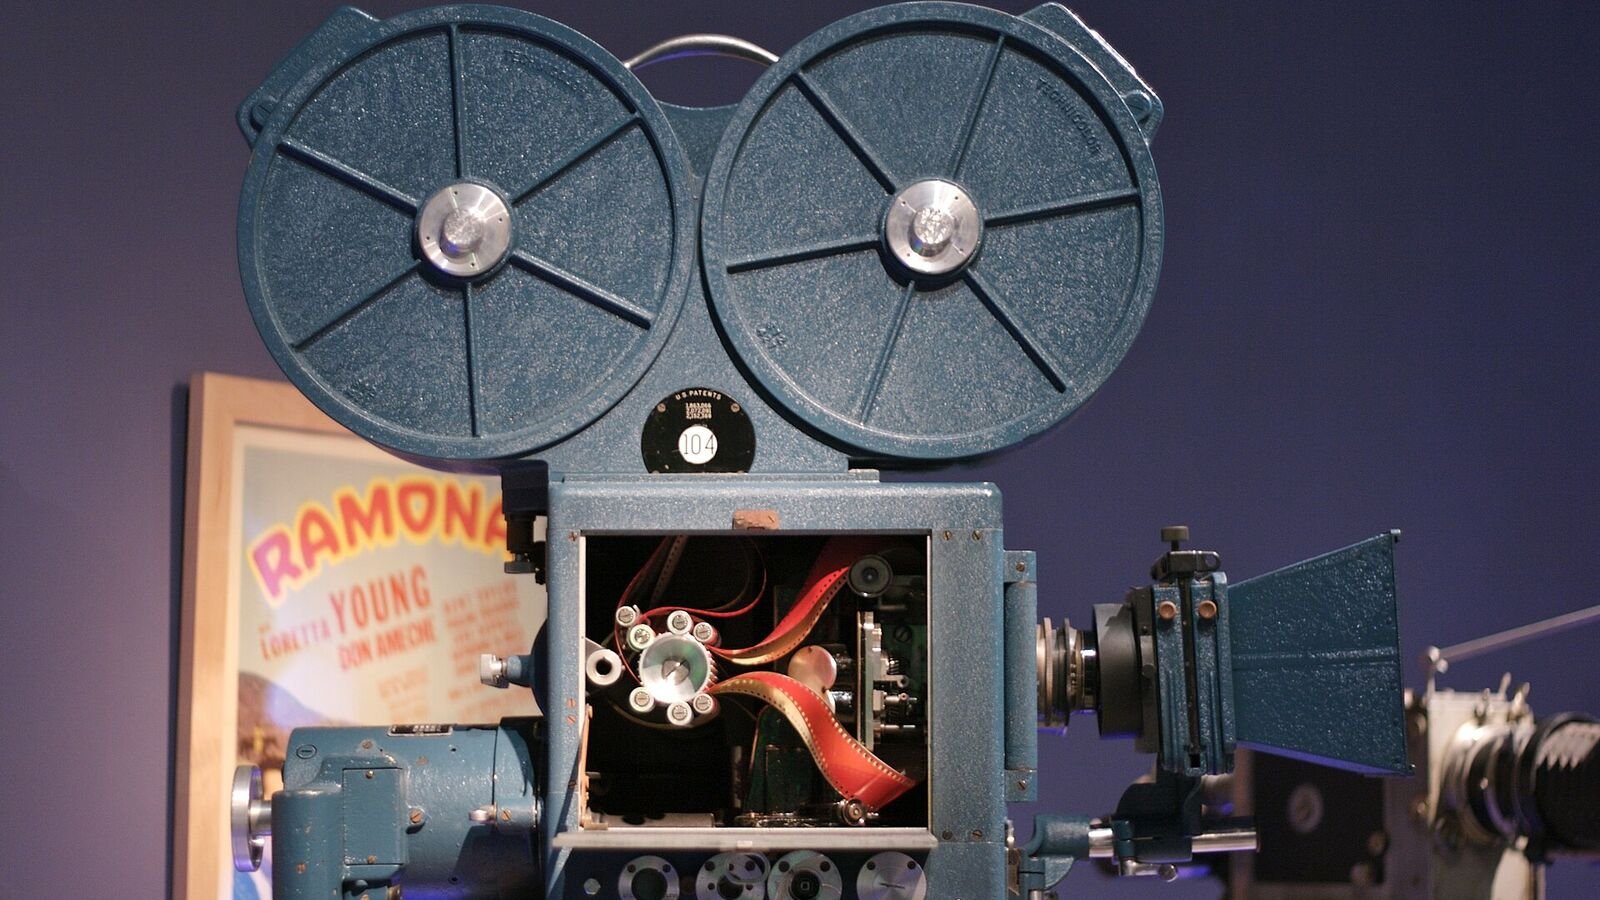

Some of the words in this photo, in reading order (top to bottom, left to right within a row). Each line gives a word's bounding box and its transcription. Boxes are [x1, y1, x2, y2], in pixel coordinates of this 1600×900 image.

[689, 390, 722, 400] PATENTS
[683, 433, 715, 455] 104
[329, 564, 432, 635] YOUNG
[338, 640, 373, 672] DON
